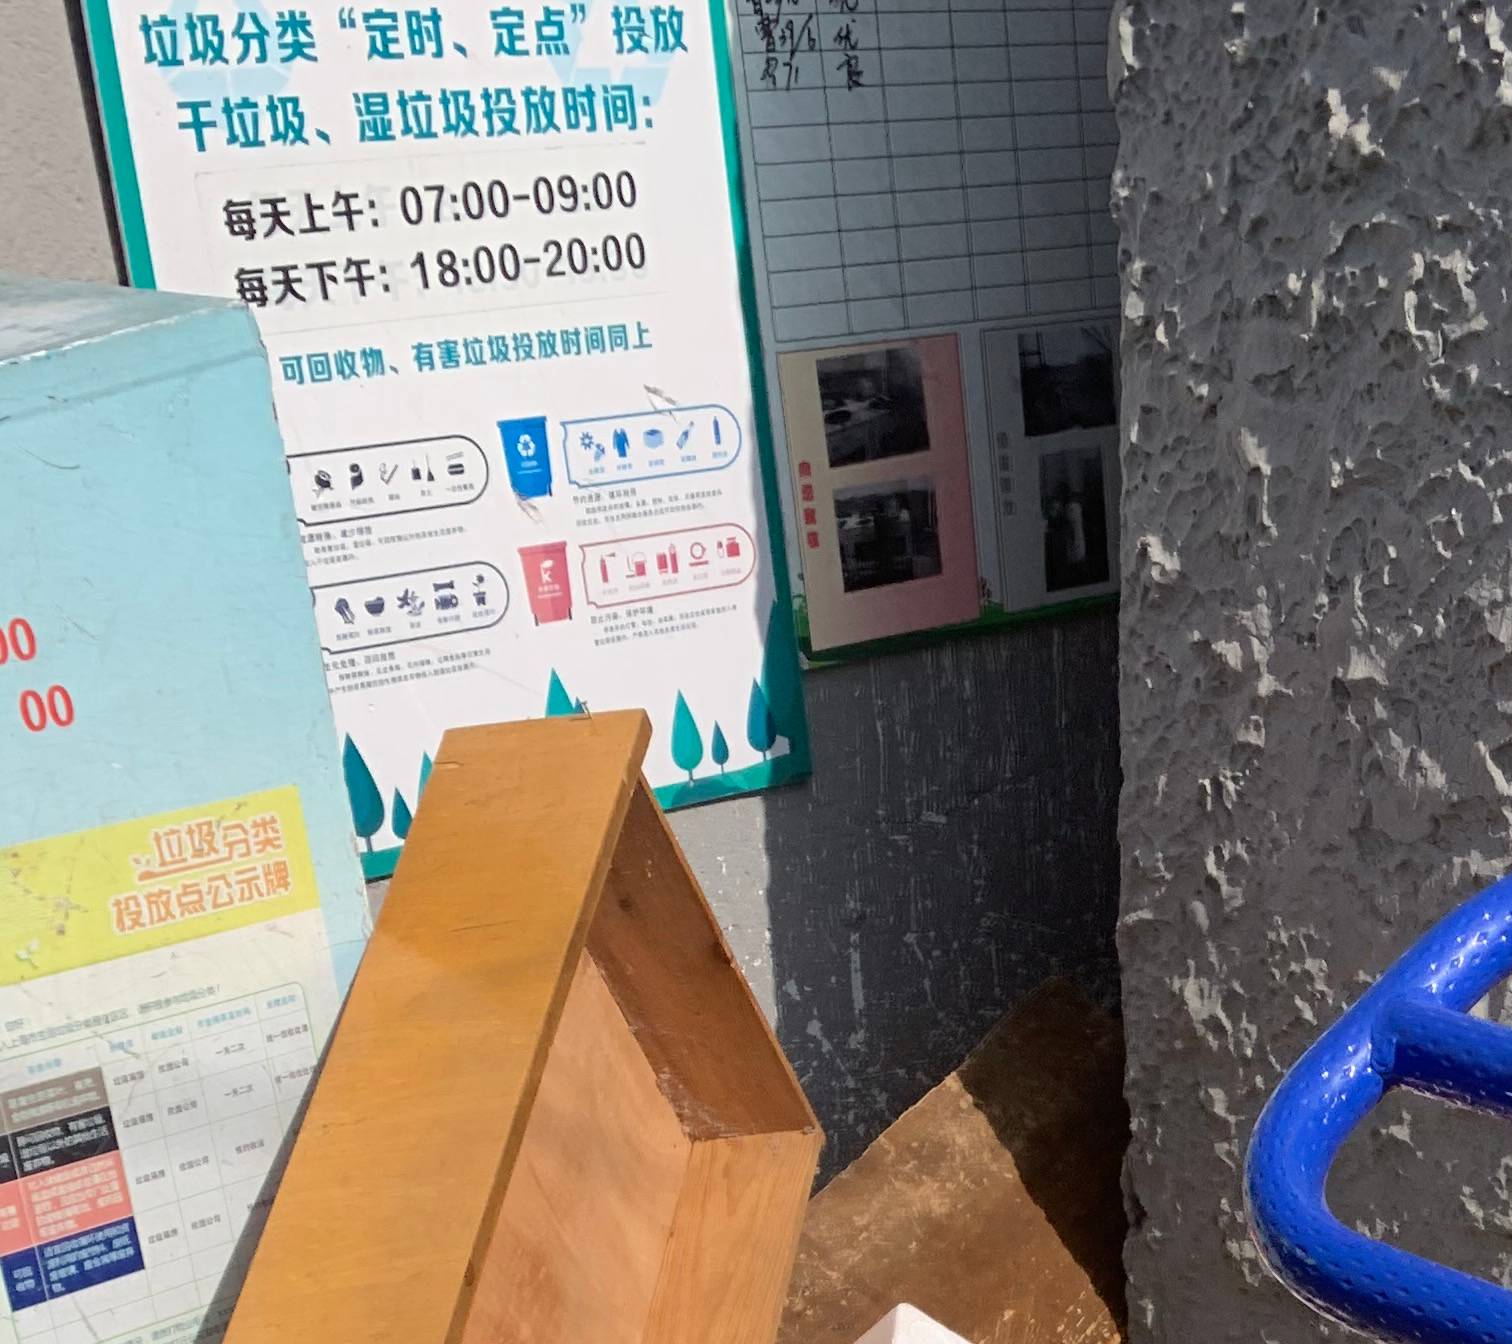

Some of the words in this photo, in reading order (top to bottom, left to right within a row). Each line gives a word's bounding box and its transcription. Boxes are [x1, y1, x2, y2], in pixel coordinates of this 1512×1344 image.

[279, 322, 653, 385] 可回收物、有害垃圾投放时间同上
[20, 684, 74, 733] 00
[152, 815, 282, 866] 垃圾分类
[114, 862, 290, 931] 投放点公示牌
